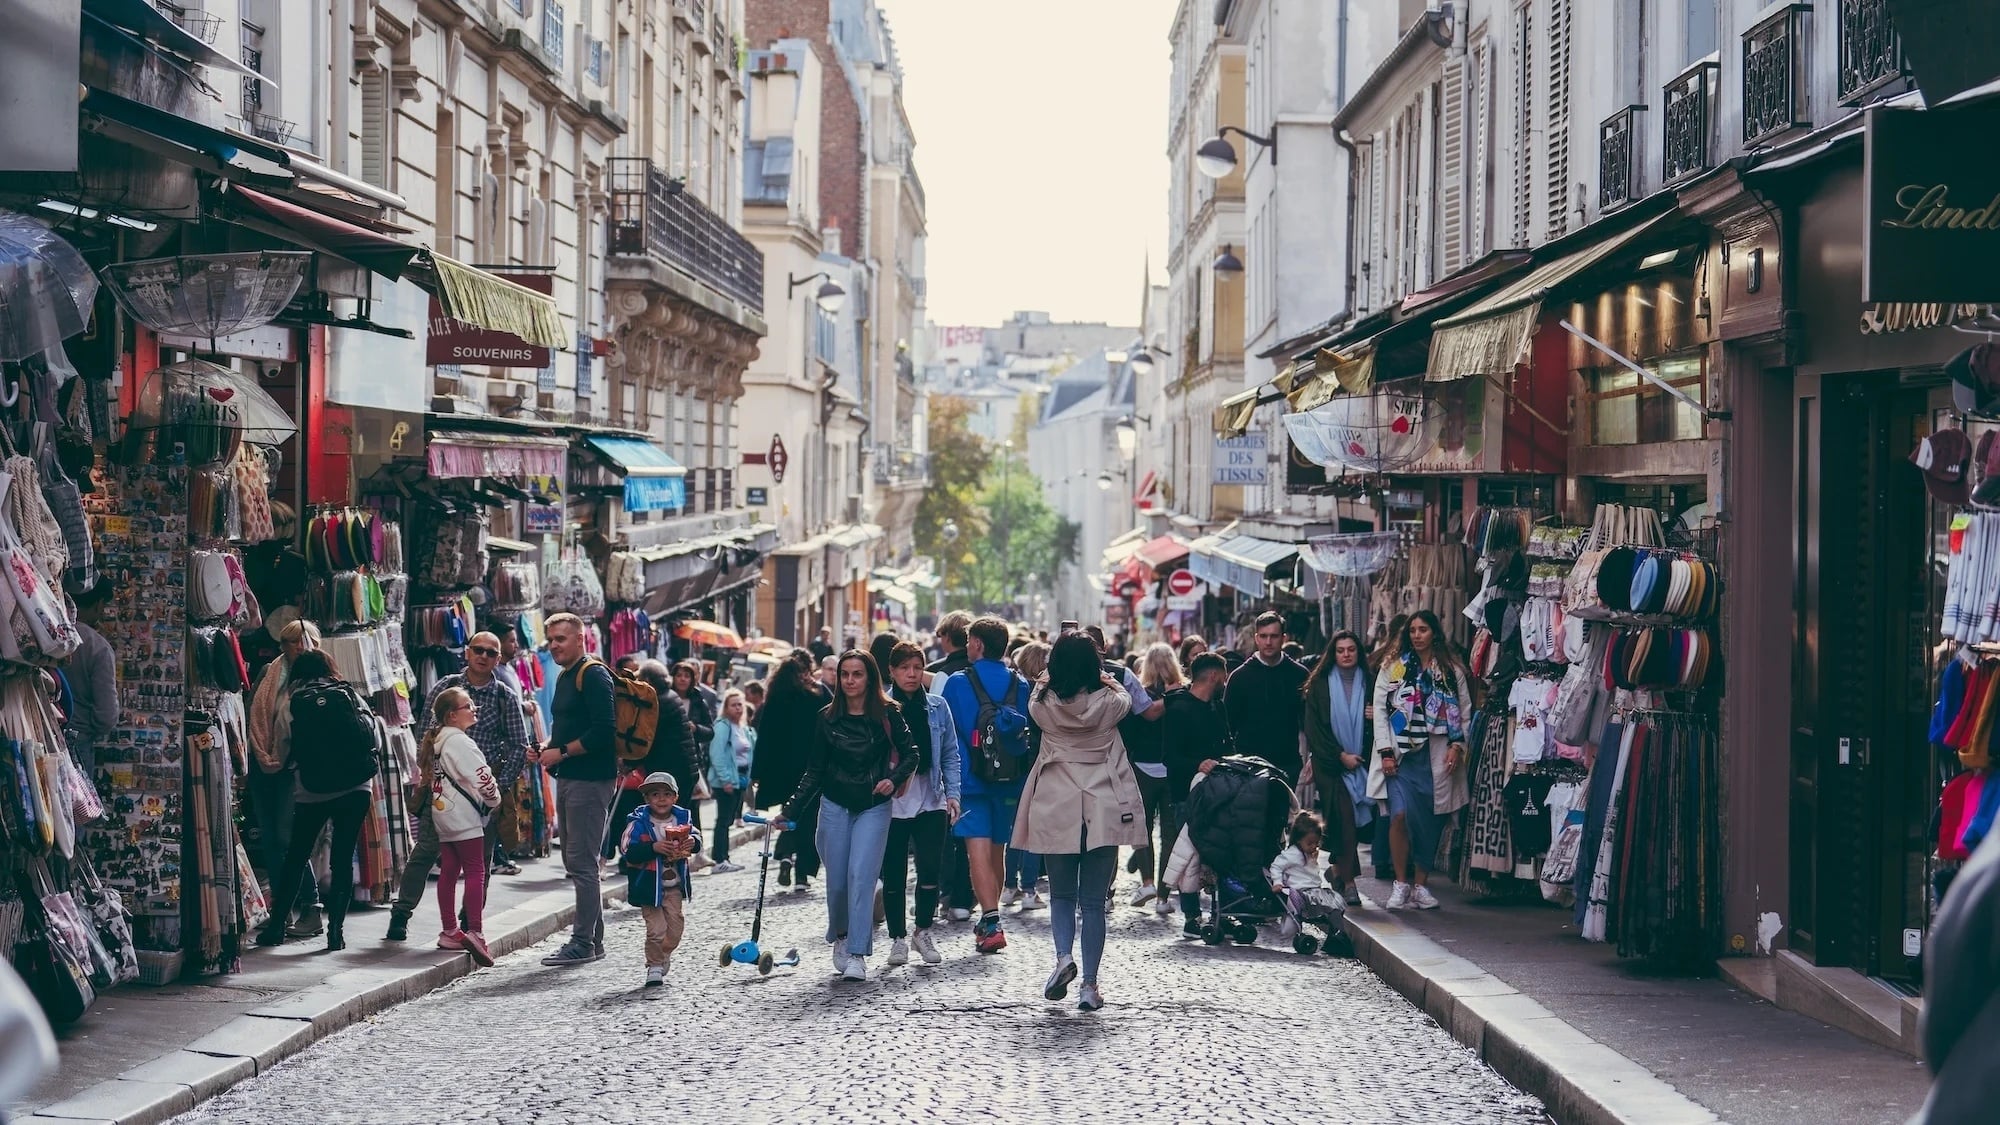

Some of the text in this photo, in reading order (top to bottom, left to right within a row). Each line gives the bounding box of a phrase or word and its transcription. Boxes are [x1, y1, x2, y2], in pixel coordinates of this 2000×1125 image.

[452, 346, 532, 361] SOUVENIRS
[186, 403, 239, 422] PARIS
[1229, 451, 1253, 465] DES
[1217, 467, 1265, 481] TISSUS
